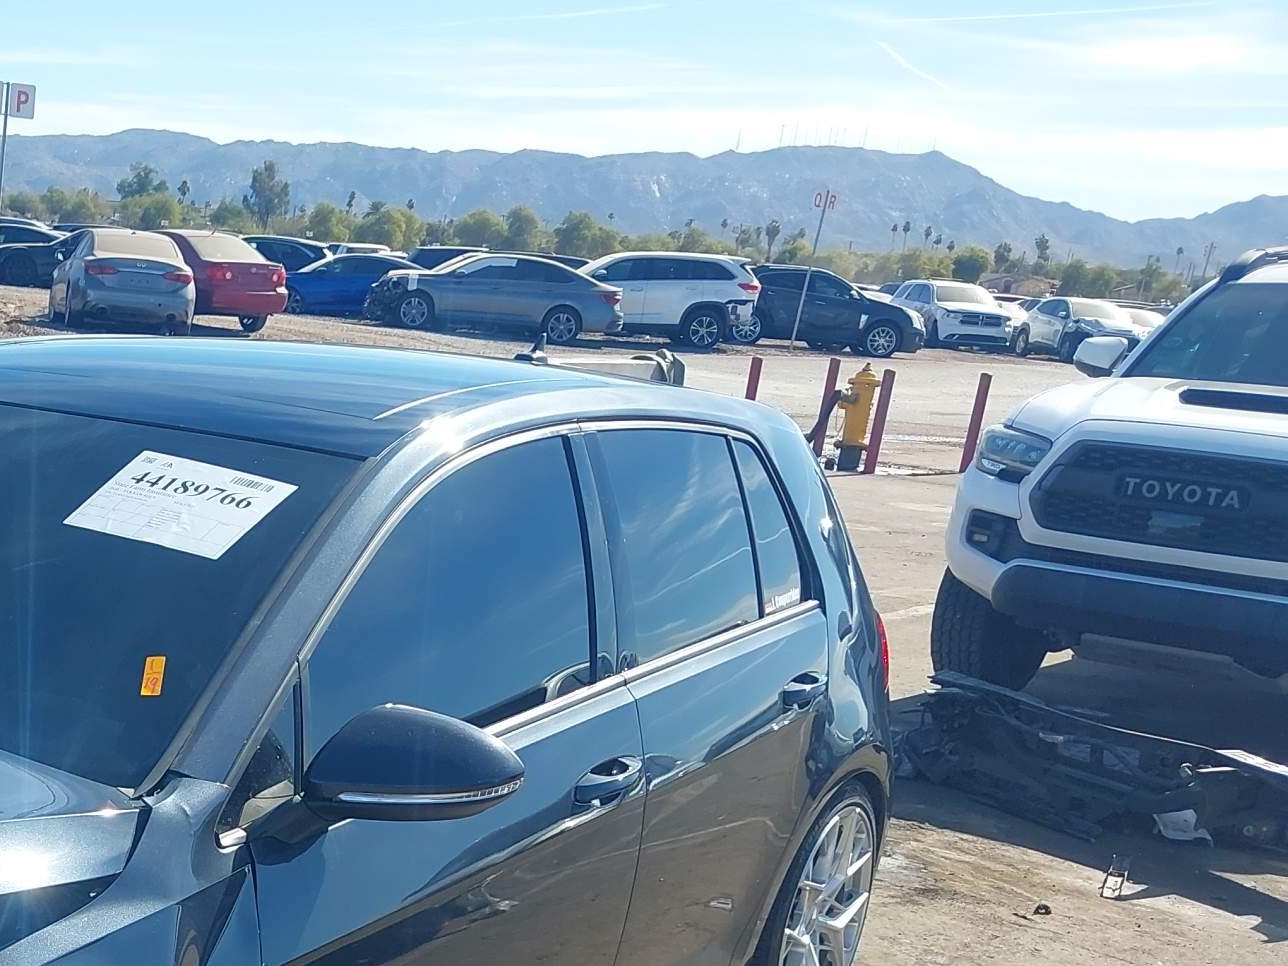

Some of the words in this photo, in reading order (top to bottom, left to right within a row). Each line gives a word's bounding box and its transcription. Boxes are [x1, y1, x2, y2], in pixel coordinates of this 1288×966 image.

[16, 90, 29, 112] P
[828, 194, 837, 209] R
[130, 471, 260, 509] 44189766
[1125, 477, 1240, 508] TOYOTA
